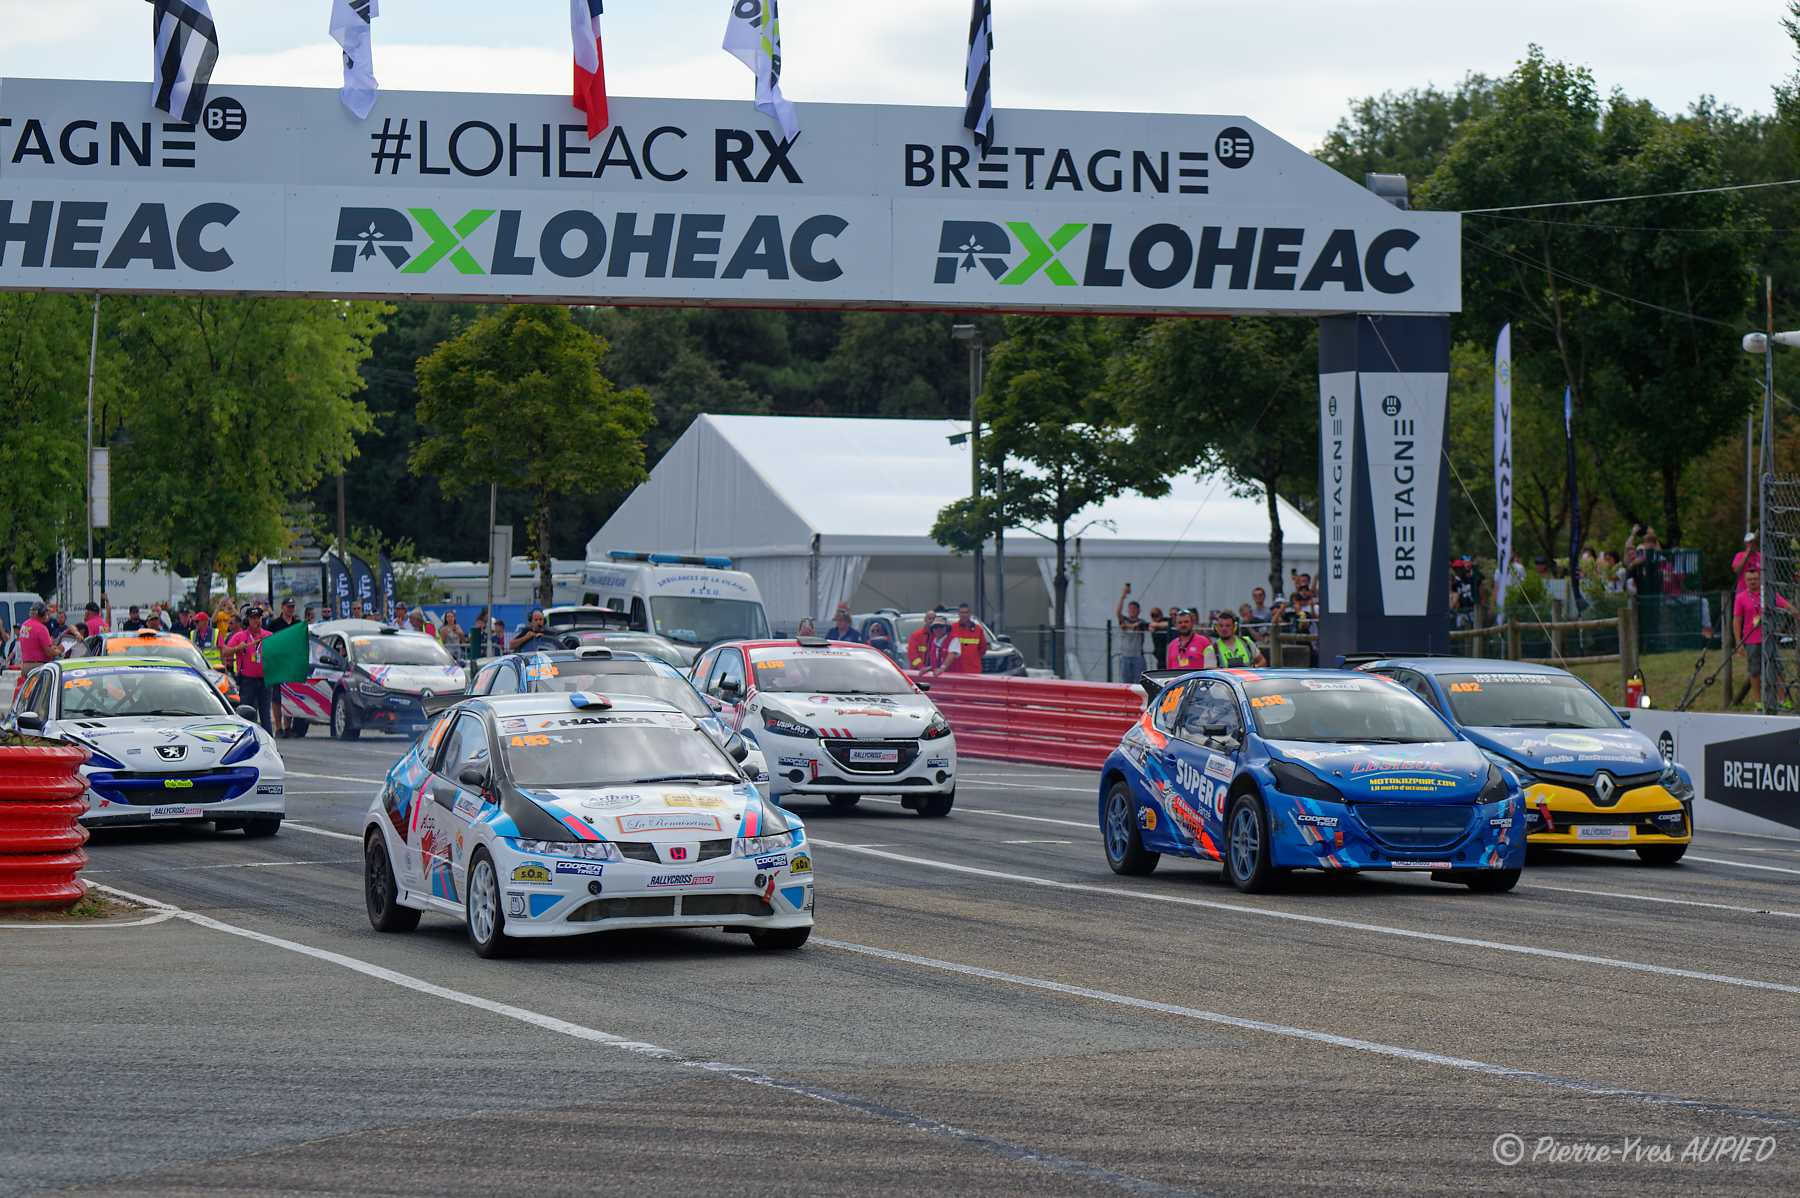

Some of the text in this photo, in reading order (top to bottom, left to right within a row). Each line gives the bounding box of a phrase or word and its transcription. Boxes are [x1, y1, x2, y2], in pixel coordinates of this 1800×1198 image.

[0, 118, 196, 168] AGNE
[370, 118, 804, 184] #LOHEAC RX
[904, 143, 1209, 194] BRETAGNE
[1333, 419, 1343, 579] BRETAGNE
[1394, 420, 1415, 581] BRETAGNE
[557, 717, 656, 726] HANSA
[776, 720, 811, 735] USIPLAST
[1175, 758, 1214, 808] SUPER
[153, 806, 185, 815] RALLYCROSS
[1298, 814, 1339, 823] COOPER
[756, 855, 786, 866] COOPER
[557, 862, 602, 876] COOPER TIRES
[650, 874, 693, 886] RALLYCROSS
